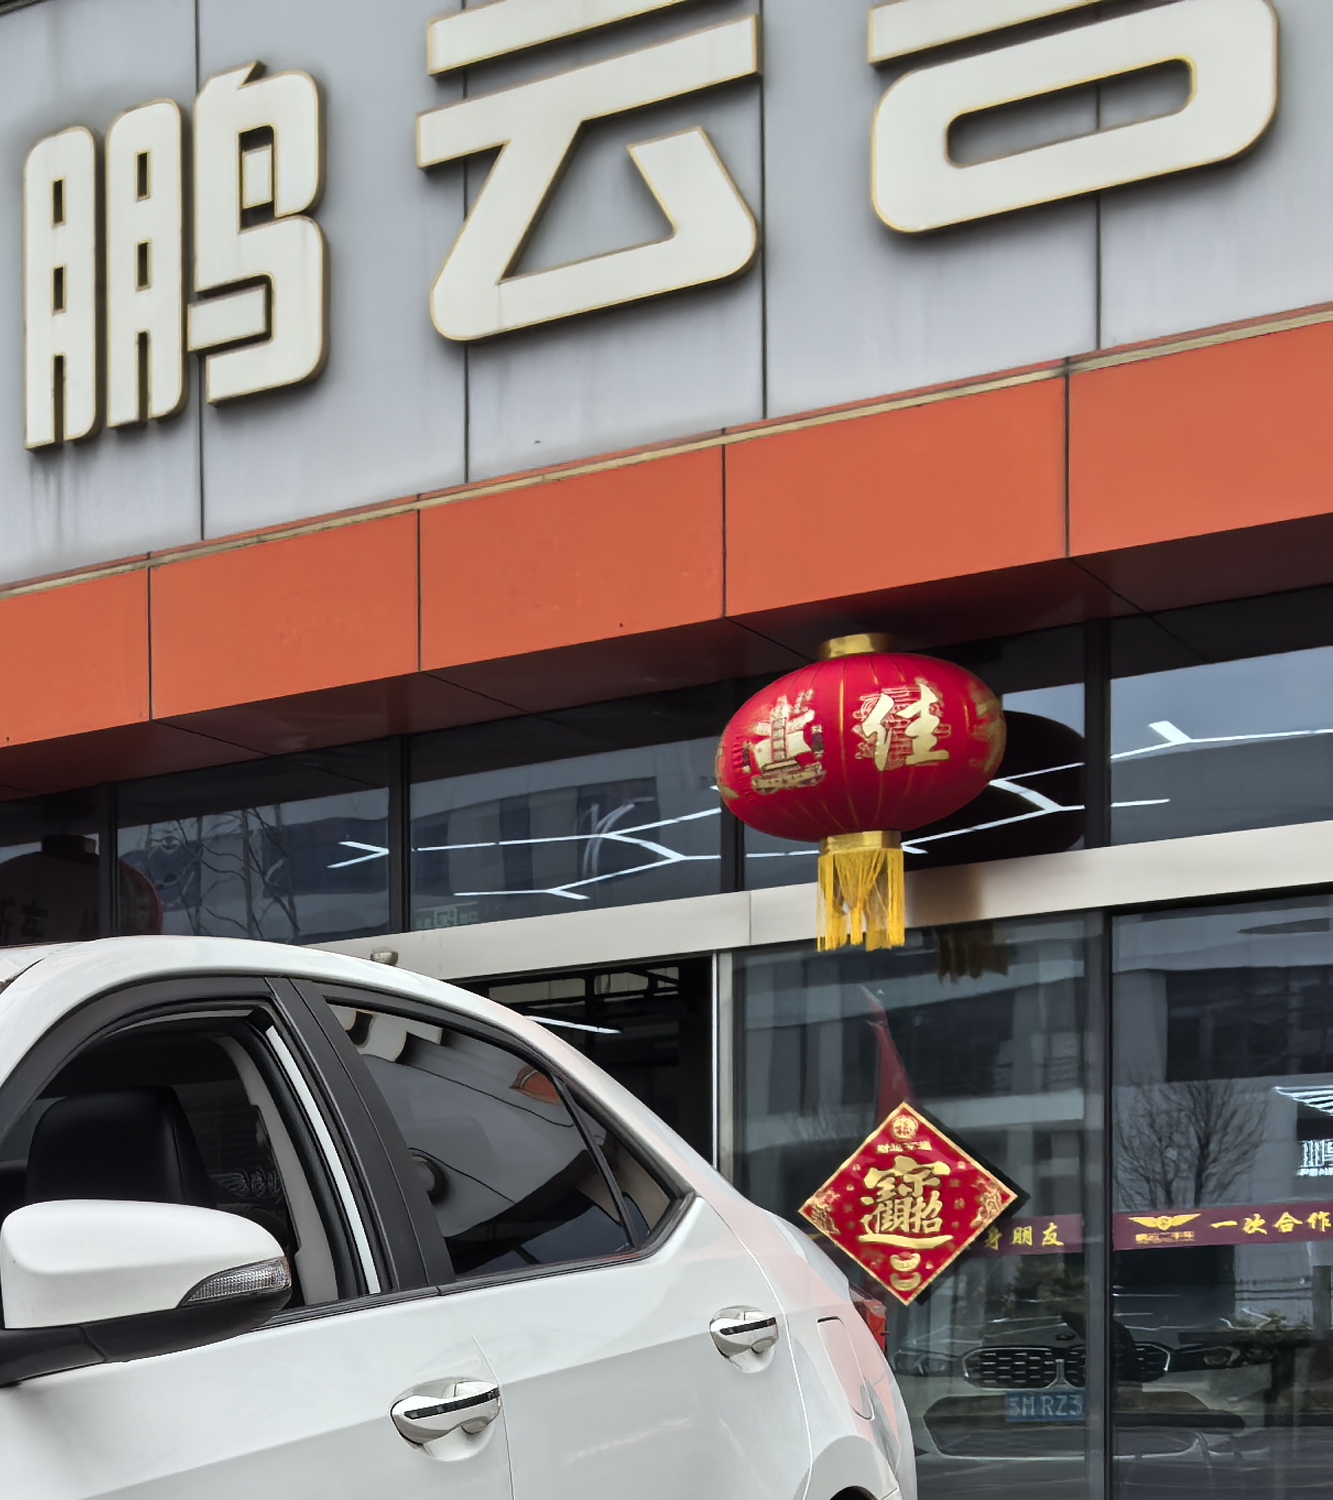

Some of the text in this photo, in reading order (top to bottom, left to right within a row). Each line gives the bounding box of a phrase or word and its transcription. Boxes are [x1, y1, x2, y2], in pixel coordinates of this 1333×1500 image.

[967, 1222, 1064, 1250] 身朋友
[1210, 1211, 1333, 1237] 一次合作
